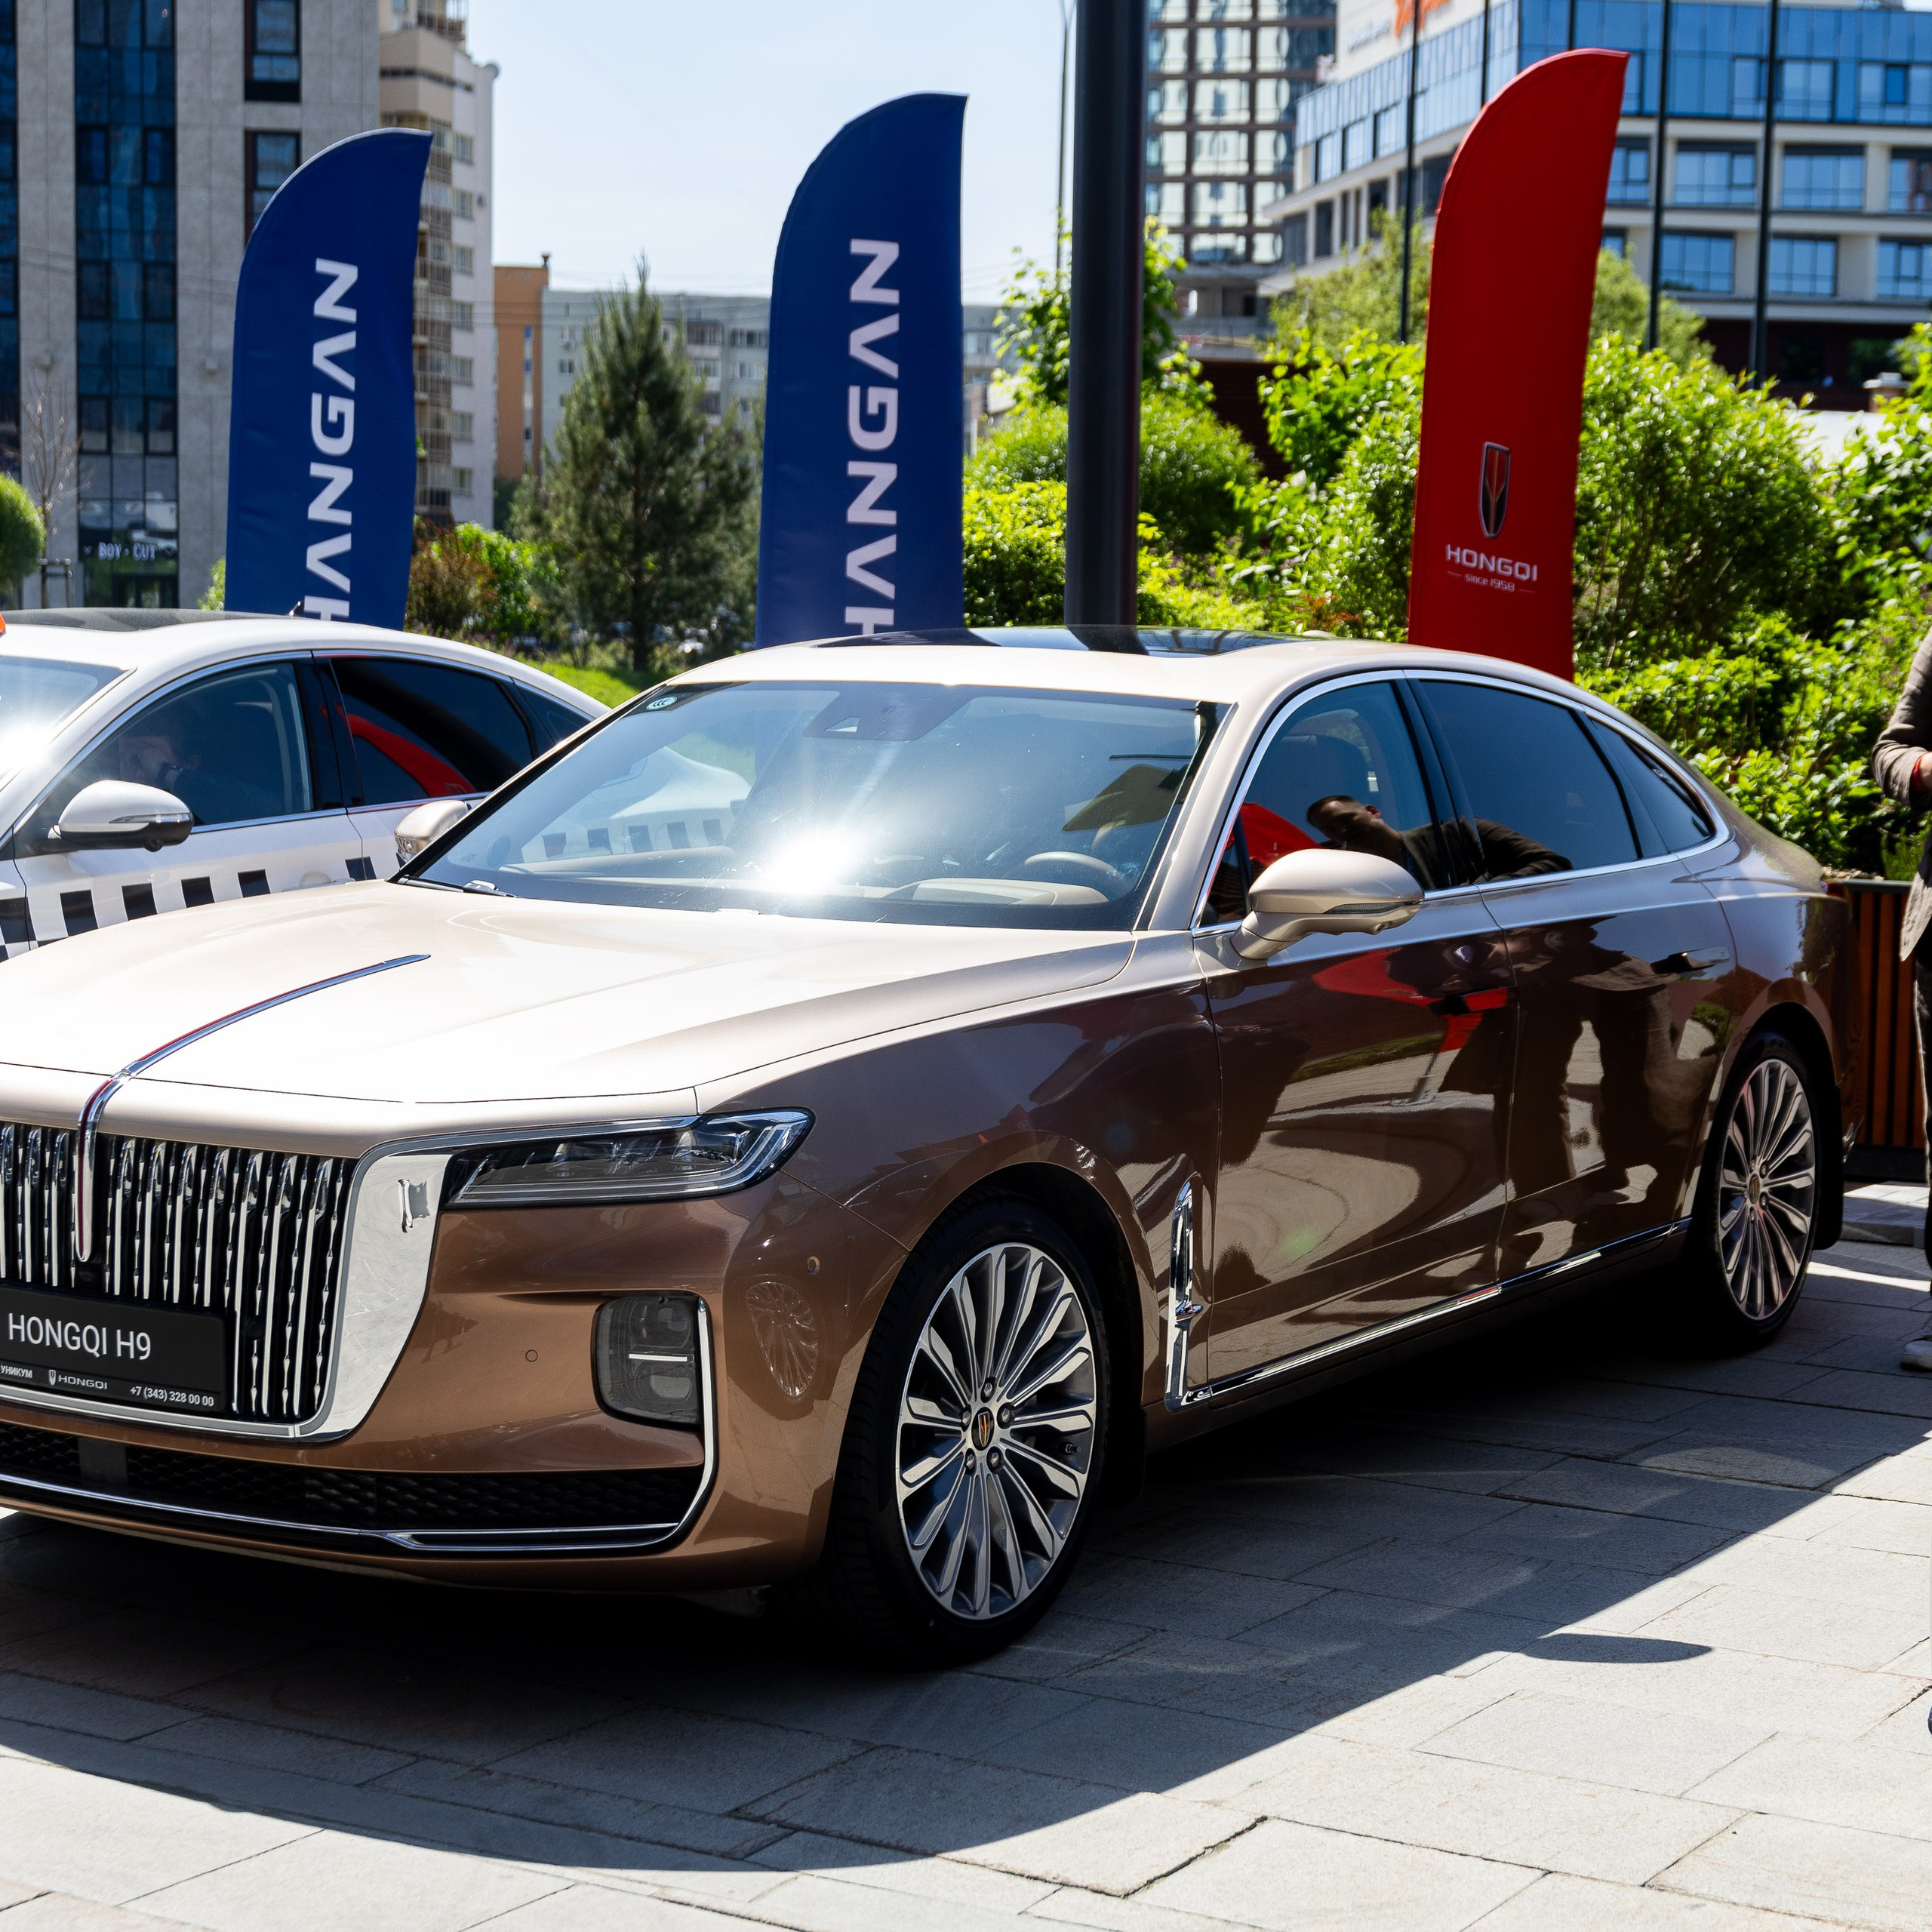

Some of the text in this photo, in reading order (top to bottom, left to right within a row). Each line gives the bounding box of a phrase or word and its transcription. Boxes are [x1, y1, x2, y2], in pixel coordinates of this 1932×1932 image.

[98, 541, 156, 561] BOY CUT
[1445, 543, 1538, 582] HONGQI
[1491, 578, 1515, 592] 1958
[8, 1312, 151, 1360] HONGQI H9
[1, 1364, 32, 1379] УНИКУМ
[58, 1374, 108, 1389] HONGQI
[130, 1386, 214, 1407] +7 (343) 328 00 00
